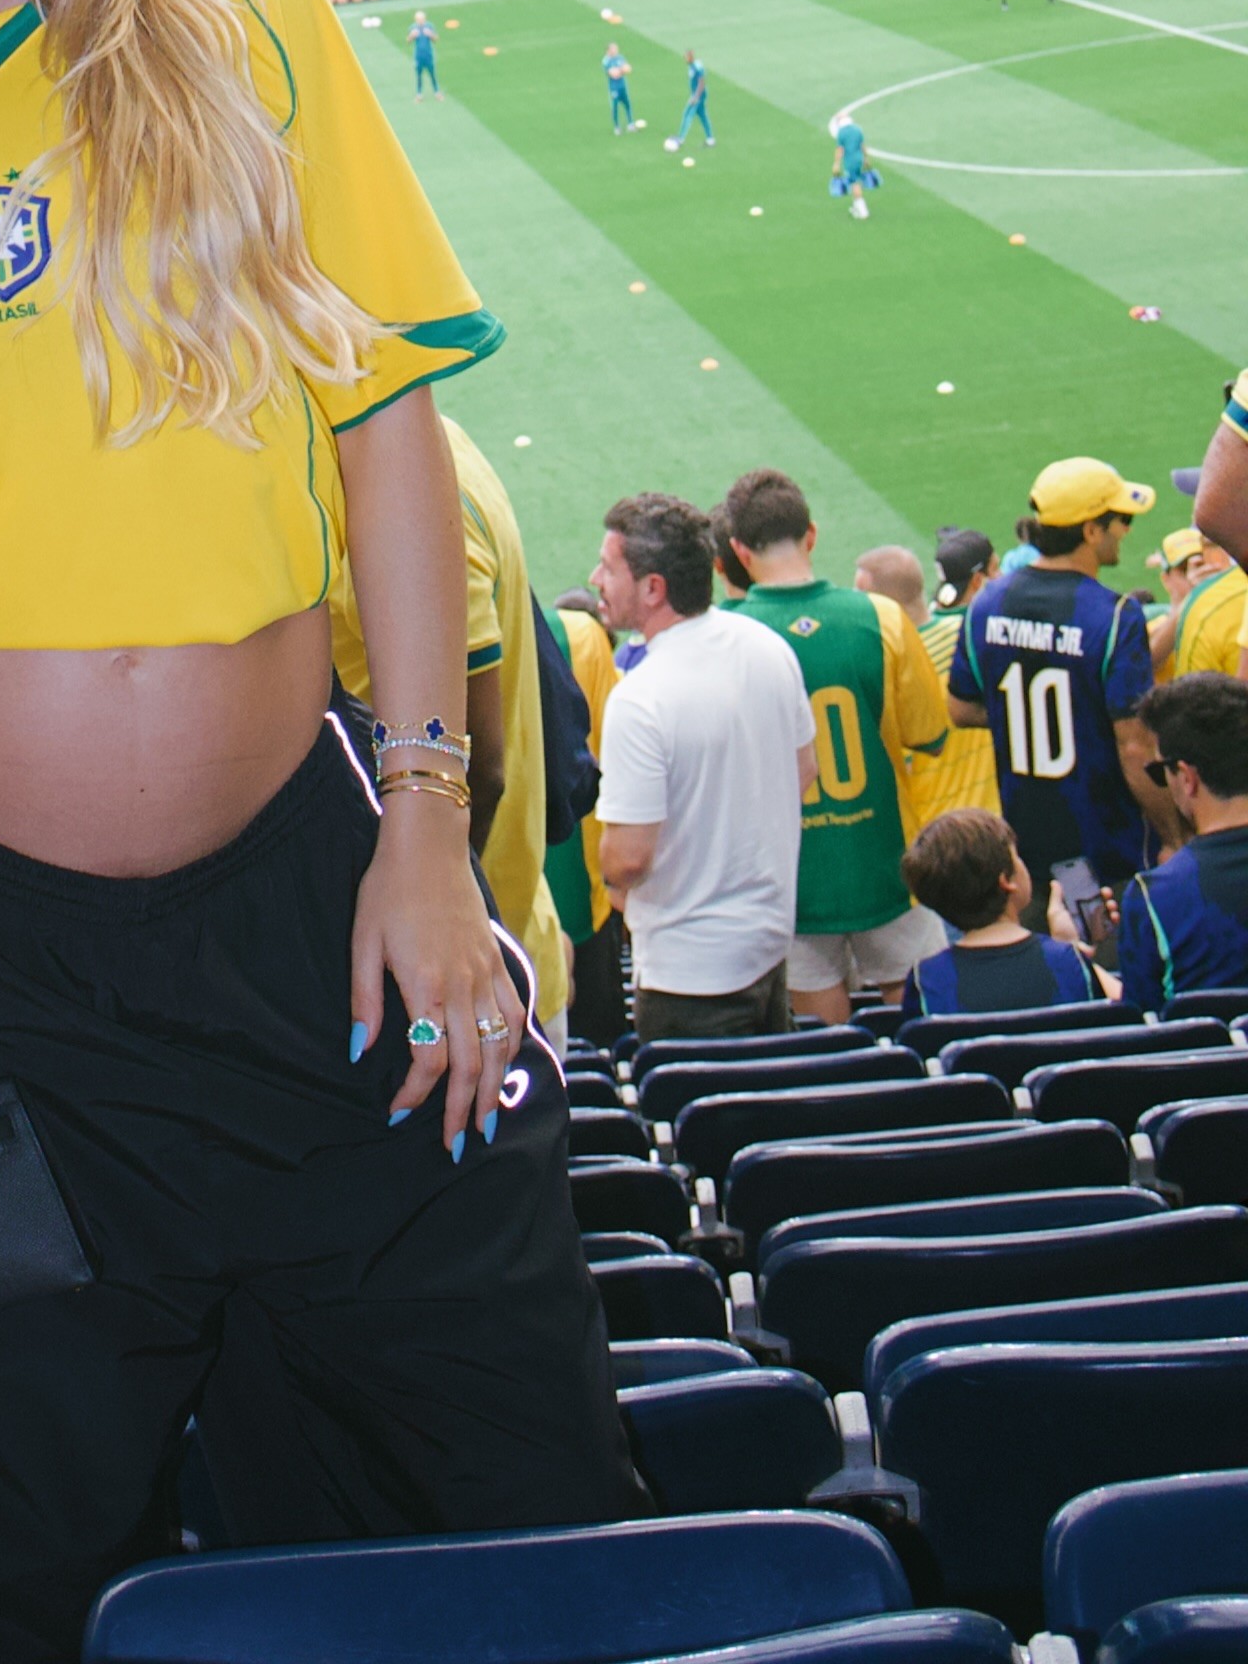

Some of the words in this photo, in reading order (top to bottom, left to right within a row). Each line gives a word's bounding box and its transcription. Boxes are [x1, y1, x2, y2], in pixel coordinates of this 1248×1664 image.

[985, 615, 1054, 652] NEYMAR
[803, 685, 867, 804] 0
[998, 662, 1076, 779] 10
